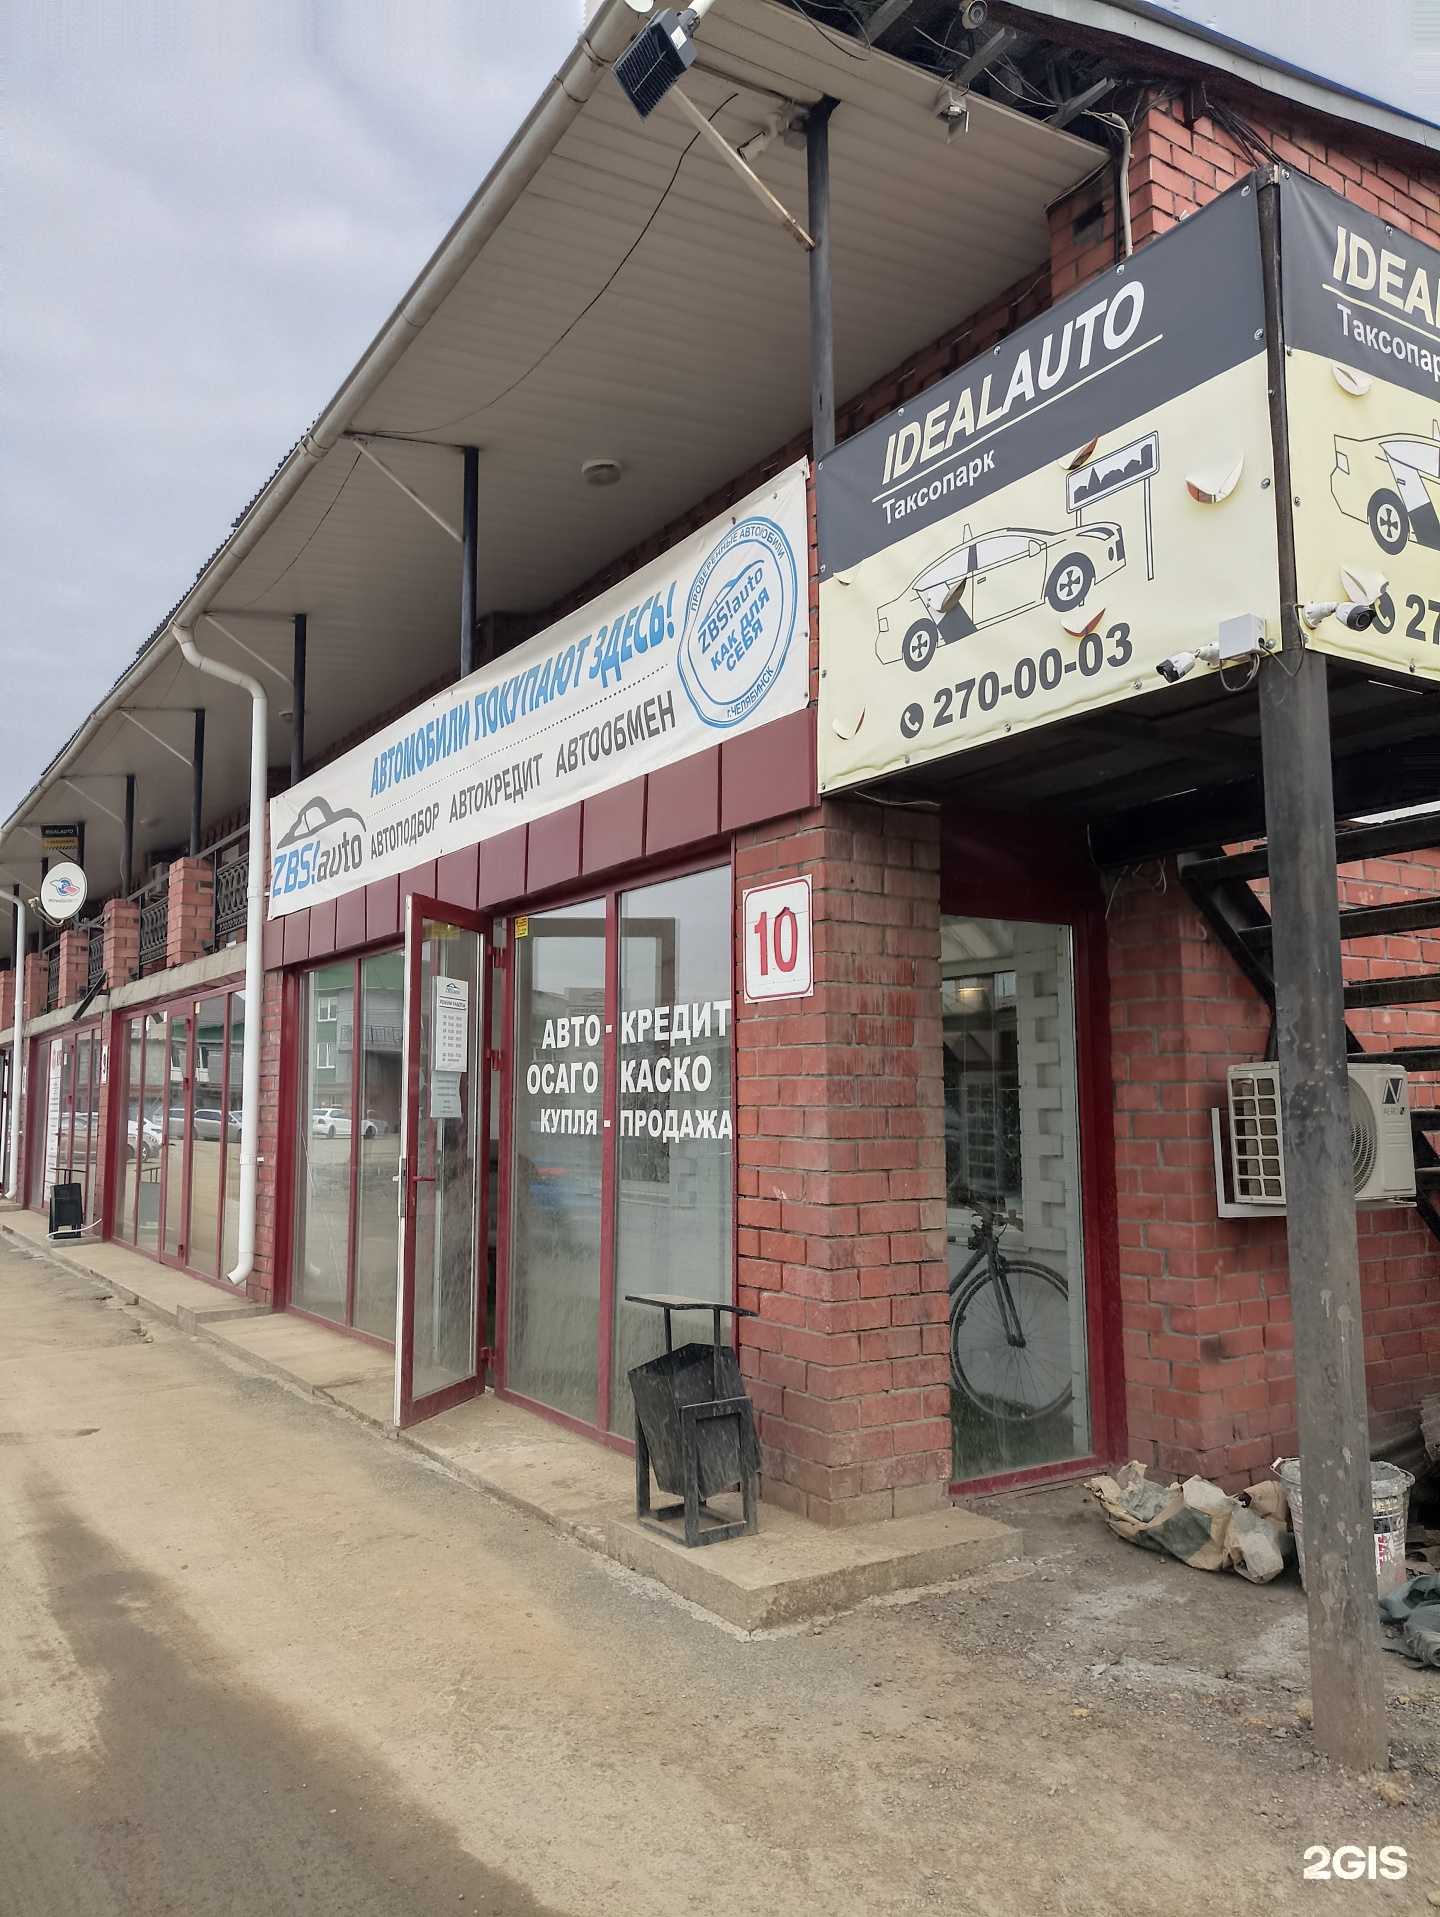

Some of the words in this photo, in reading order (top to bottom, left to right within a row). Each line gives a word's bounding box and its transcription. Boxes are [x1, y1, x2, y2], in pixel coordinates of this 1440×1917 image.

[1333, 225, 1440, 328] IDEA
[881, 280, 1145, 485] IDEALAUTO
[882, 448, 996, 525] Таксопарк
[711, 629, 739, 672] КАК
[726, 618, 764, 672] СЕБЯ
[932, 622, 1133, 729] 270-00-03
[370, 700, 471, 798] АВТОМОБИЛИ
[474, 634, 593, 741] ПОКУПАЮТ
[588, 580, 677, 689] ЗДЕСЬ!
[370, 802, 440, 860] АВТОПОДБОР
[449, 753, 543, 824] АВТОКРЕДИТ
[556, 690, 676, 778] АВТООБМЕН
[272, 831, 363, 898] ZBS!auto
[754, 906, 798, 977] 10
[621, 1000, 732, 1046] КРЕДИТ
[526, 1061, 599, 1094] ОСАГО
[620, 1055, 712, 1093] КАСКО
[619, 1109, 733, 1144] ПРОДАЖА
